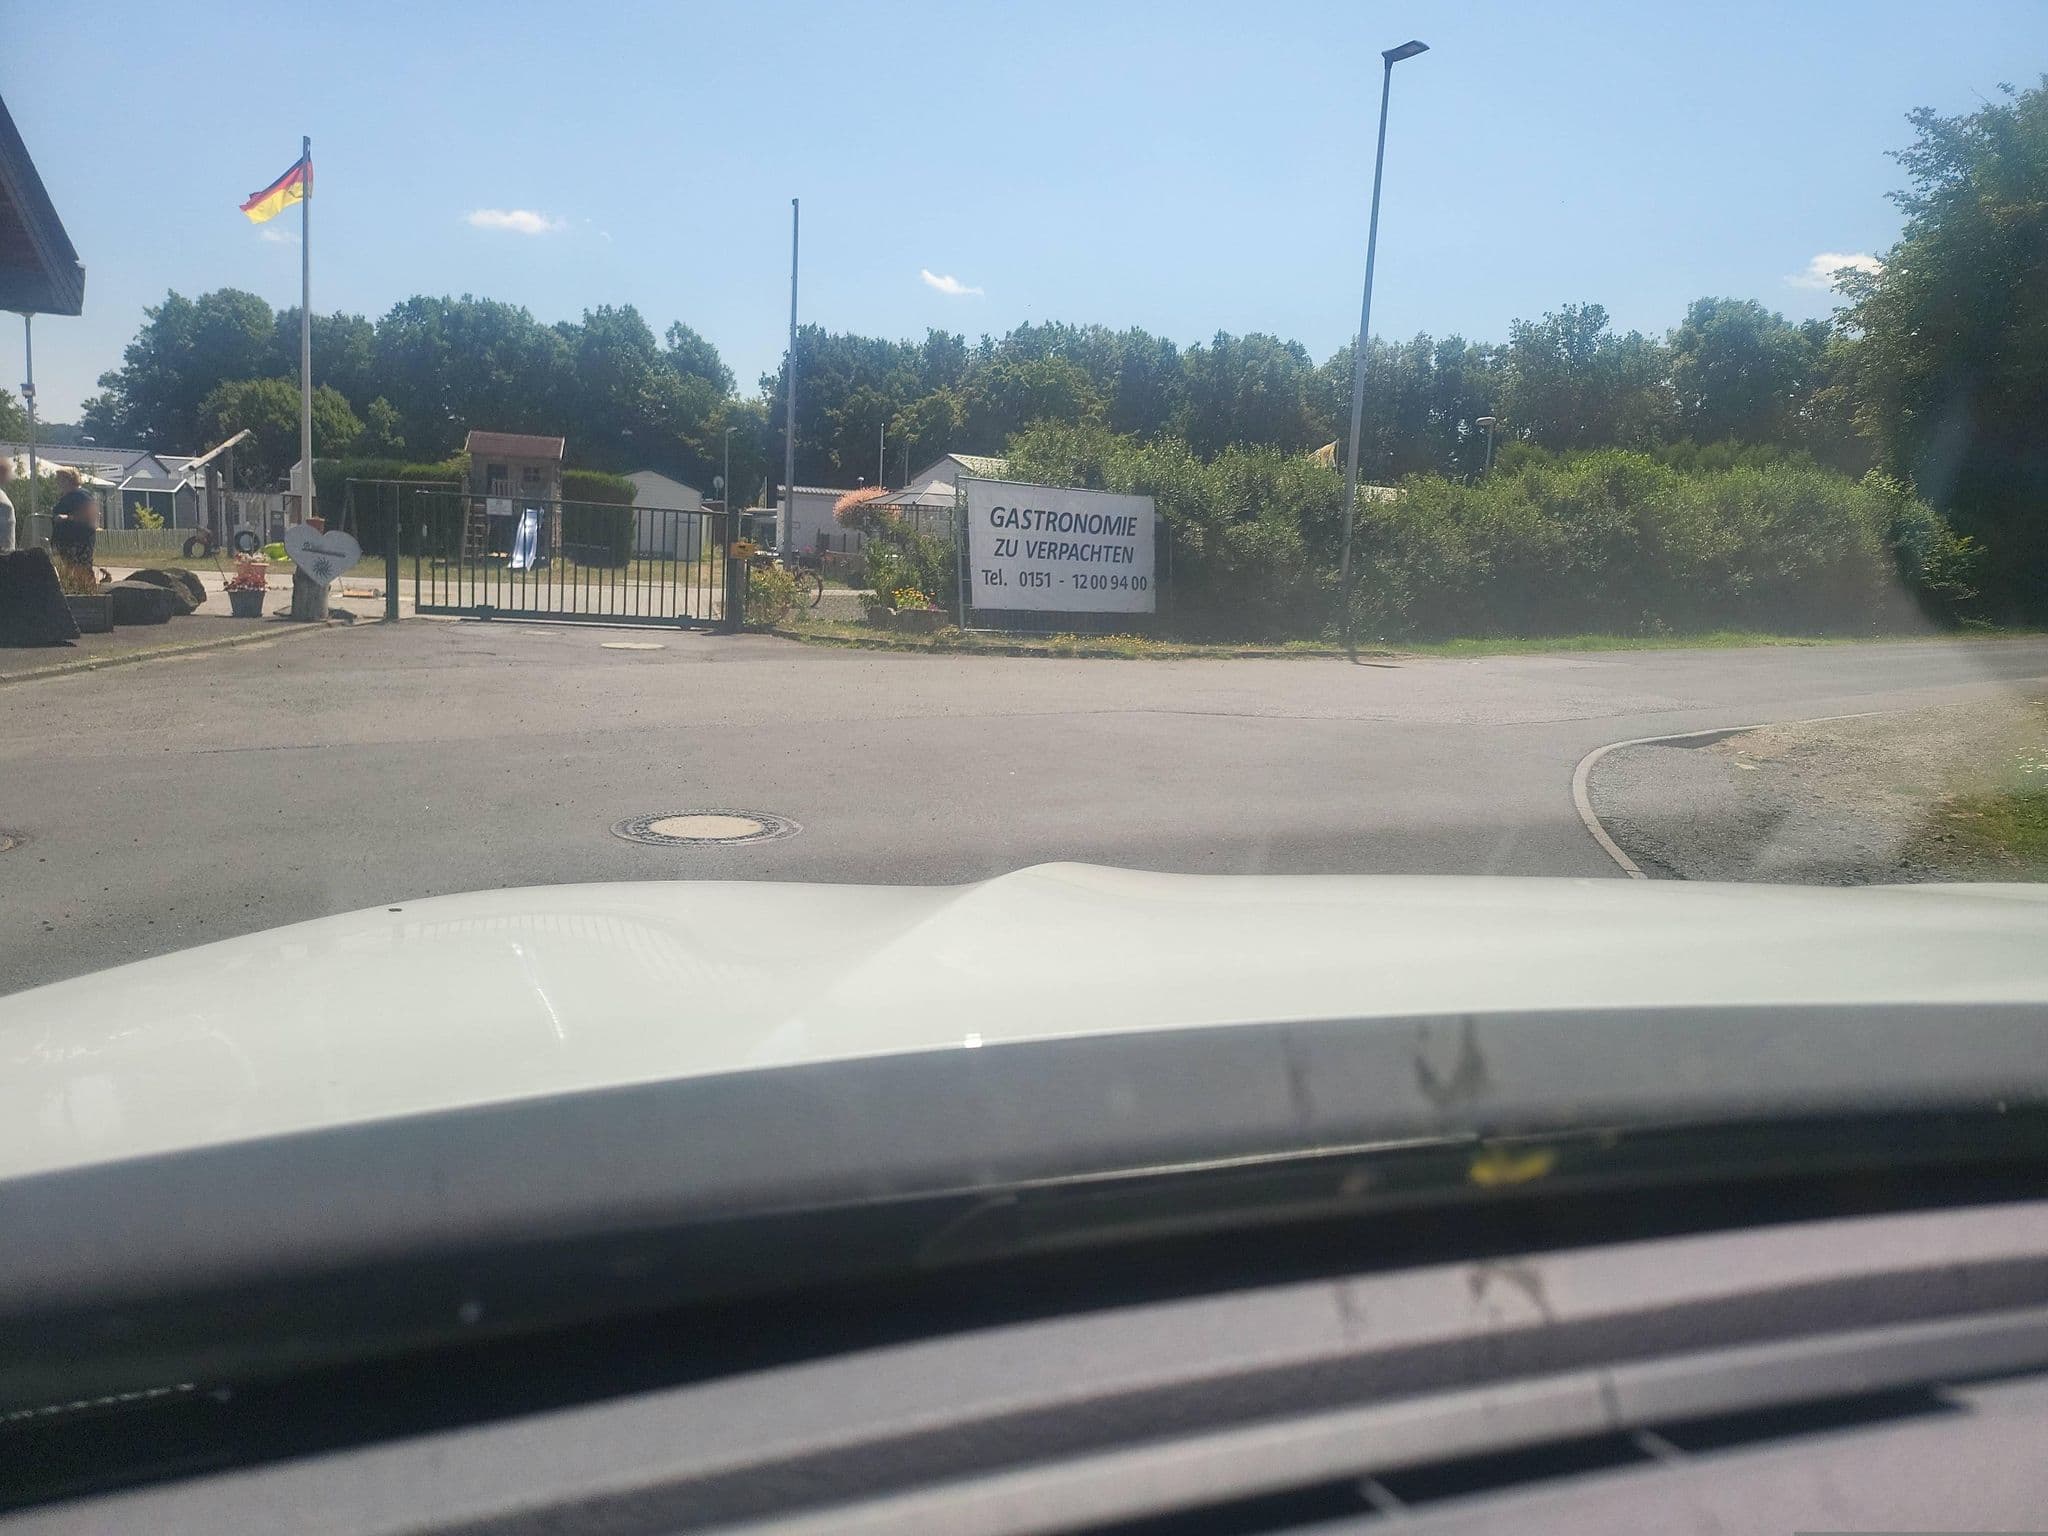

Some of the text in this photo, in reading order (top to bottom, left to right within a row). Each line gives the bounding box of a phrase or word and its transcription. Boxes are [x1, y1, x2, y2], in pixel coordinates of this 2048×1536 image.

[990, 506, 1138, 537] GASTRONOMIE
[993, 538, 1135, 564] ZU VERPACHTEN
[981, 568, 1008, 587] Tel.
[1019, 571, 1051, 588] 0151
